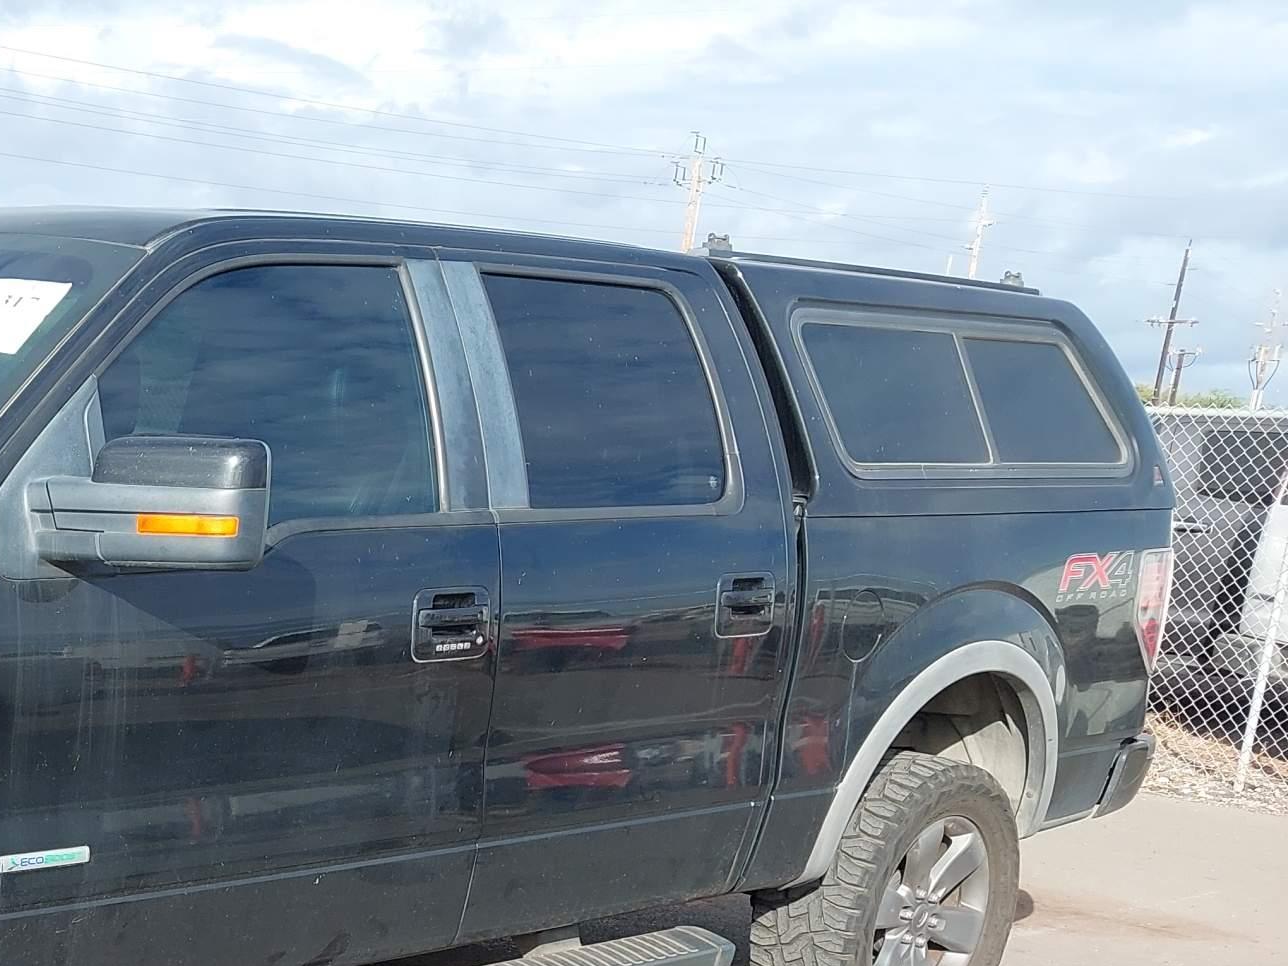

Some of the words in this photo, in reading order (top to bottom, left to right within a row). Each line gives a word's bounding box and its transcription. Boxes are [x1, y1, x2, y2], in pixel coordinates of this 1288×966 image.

[1057, 549, 1135, 593] FX4
[1055, 593, 1084, 603] OFF
[1088, 589, 1128, 601] ROAD
